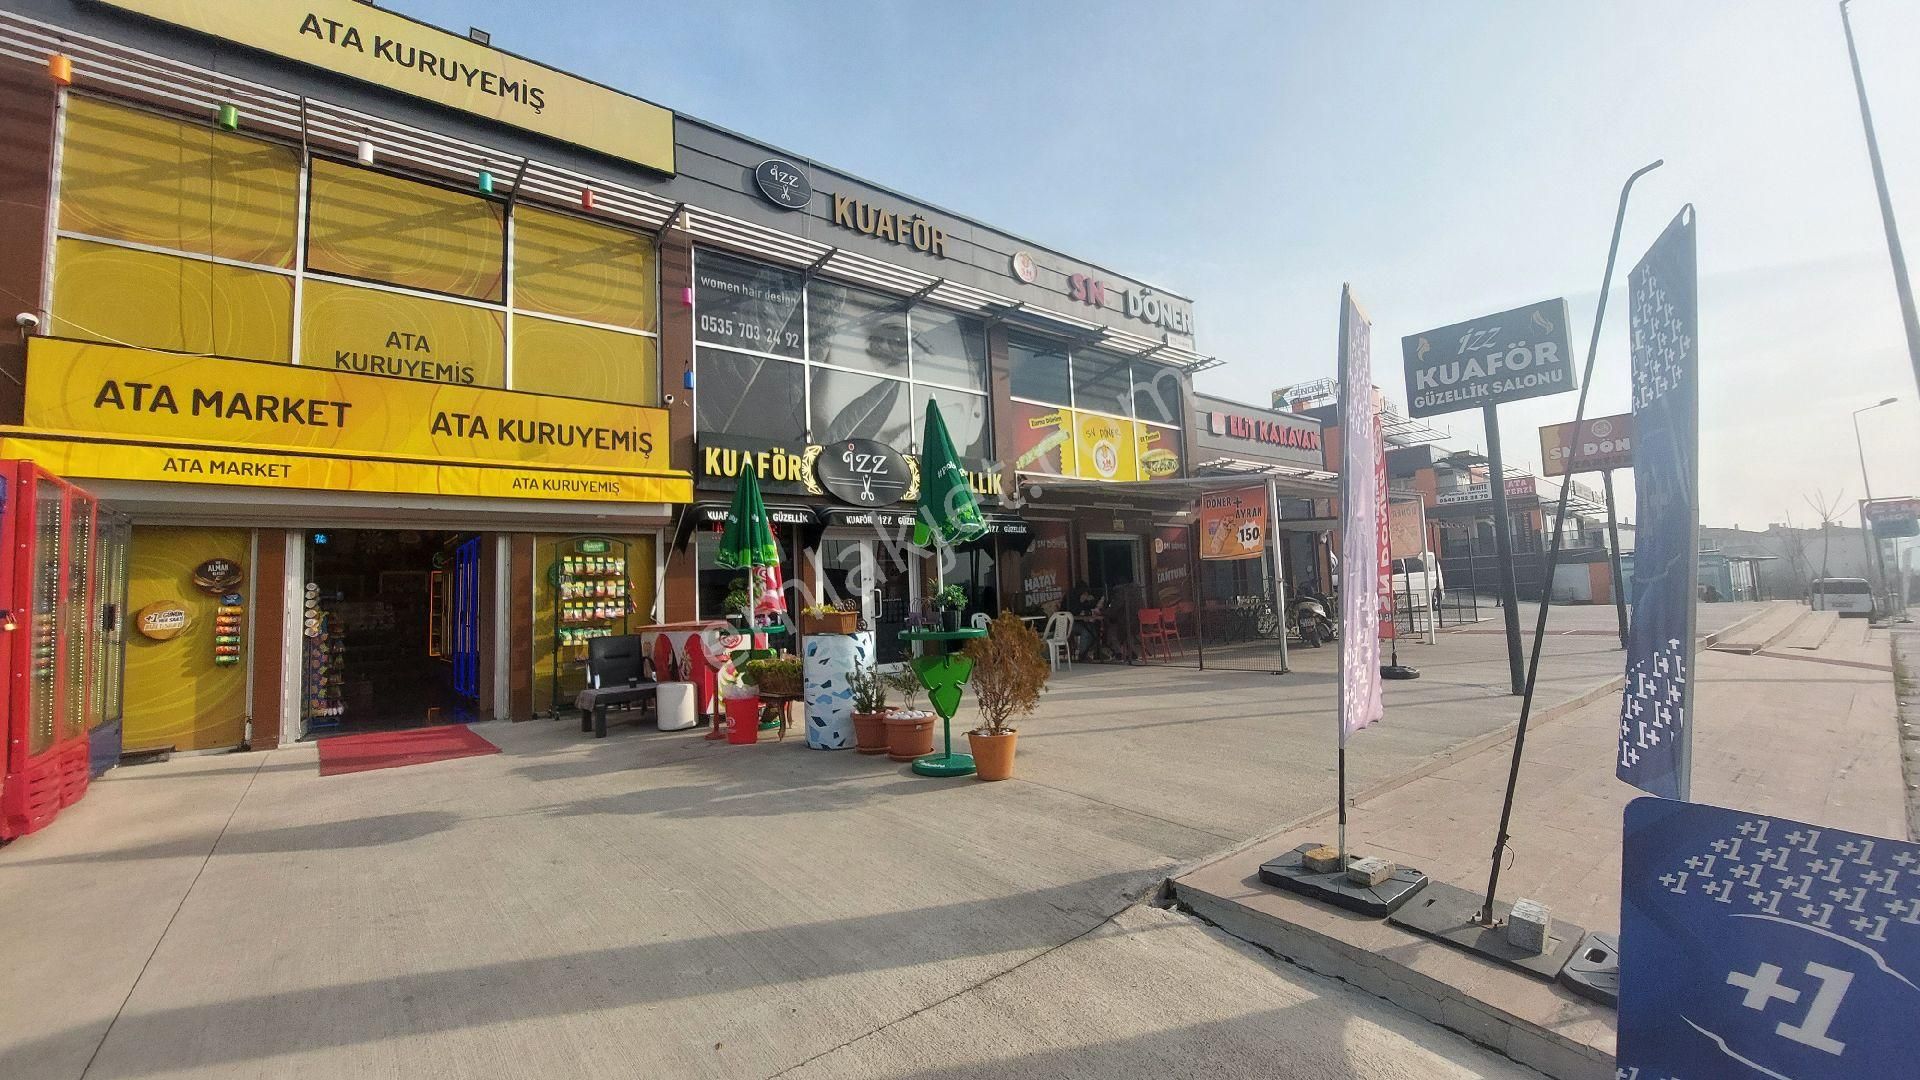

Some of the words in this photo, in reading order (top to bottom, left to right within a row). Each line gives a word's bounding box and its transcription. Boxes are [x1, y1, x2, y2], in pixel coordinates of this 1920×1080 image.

[299, 12, 365, 53] ATA
[374, 34, 546, 115] KURUYEMİŞ
[833, 192, 949, 256] KUAFÖR
[700, 276, 740, 293] women
[742, 284, 763, 299] hair
[764, 290, 797, 308] design
[1069, 273, 1105, 305] SN
[1126, 287, 1194, 335] DÖNER
[385, 331, 431, 353] ATA
[701, 314, 733, 336] 0535
[738, 322, 761, 340] 703
[766, 328, 781, 345] 24
[785, 331, 800, 349] 92
[335, 350, 475, 385] KURUYEMİŞ
[1415, 340, 1561, 391] KUAFÖR
[1414, 382, 1489, 409] GÜZELLİK
[1492, 368, 1563, 394] SALONU
[93, 380, 179, 415] ATA
[191, 388, 353, 428] MARKET
[430, 411, 490, 441] ATA
[497, 418, 654, 460] KURUYEMİŞ
[1259, 419, 1319, 450] KARAVAN
[163, 457, 204, 475] ATA
[209, 460, 292, 479] MARKET
[512, 477, 539, 491] ATA
[542, 479, 620, 496] KURUYEMİŞ
[1504, 487, 1533, 495] TERZİ
[773, 511, 808, 523] GÜZELLİK
[846, 514, 872, 525] KUAFÖR
[1235, 507, 1262, 519] AYRAN
[1004, 525, 1028, 533] GÜZELLİK
[1239, 527, 1260, 543] 150
[1024, 573, 1057, 592] HATAY
[1736, 819, 1770, 844] +1
[1785, 829, 1822, 855] +1
[1710, 837, 1743, 861] +1
[1756, 846, 1791, 872] +1
[1836, 840, 1876, 866] +1
[1684, 854, 1716, 878] +1
[1729, 864, 1764, 888] +1
[1807, 858, 1844, 883] +1
[1658, 871, 1689, 895] +1
[1702, 880, 1734, 904] +1
[1777, 875, 1813, 900] +1
[1860, 869, 1900, 895] +1
[1748, 891, 1782, 915] +1
[1829, 887, 1868, 913] +1
[1884, 899, 1920, 925] +1
[1797, 904, 1834, 929] +1
[1850, 916, 1890, 942] +1
[1726, 961, 1855, 1056] +1
